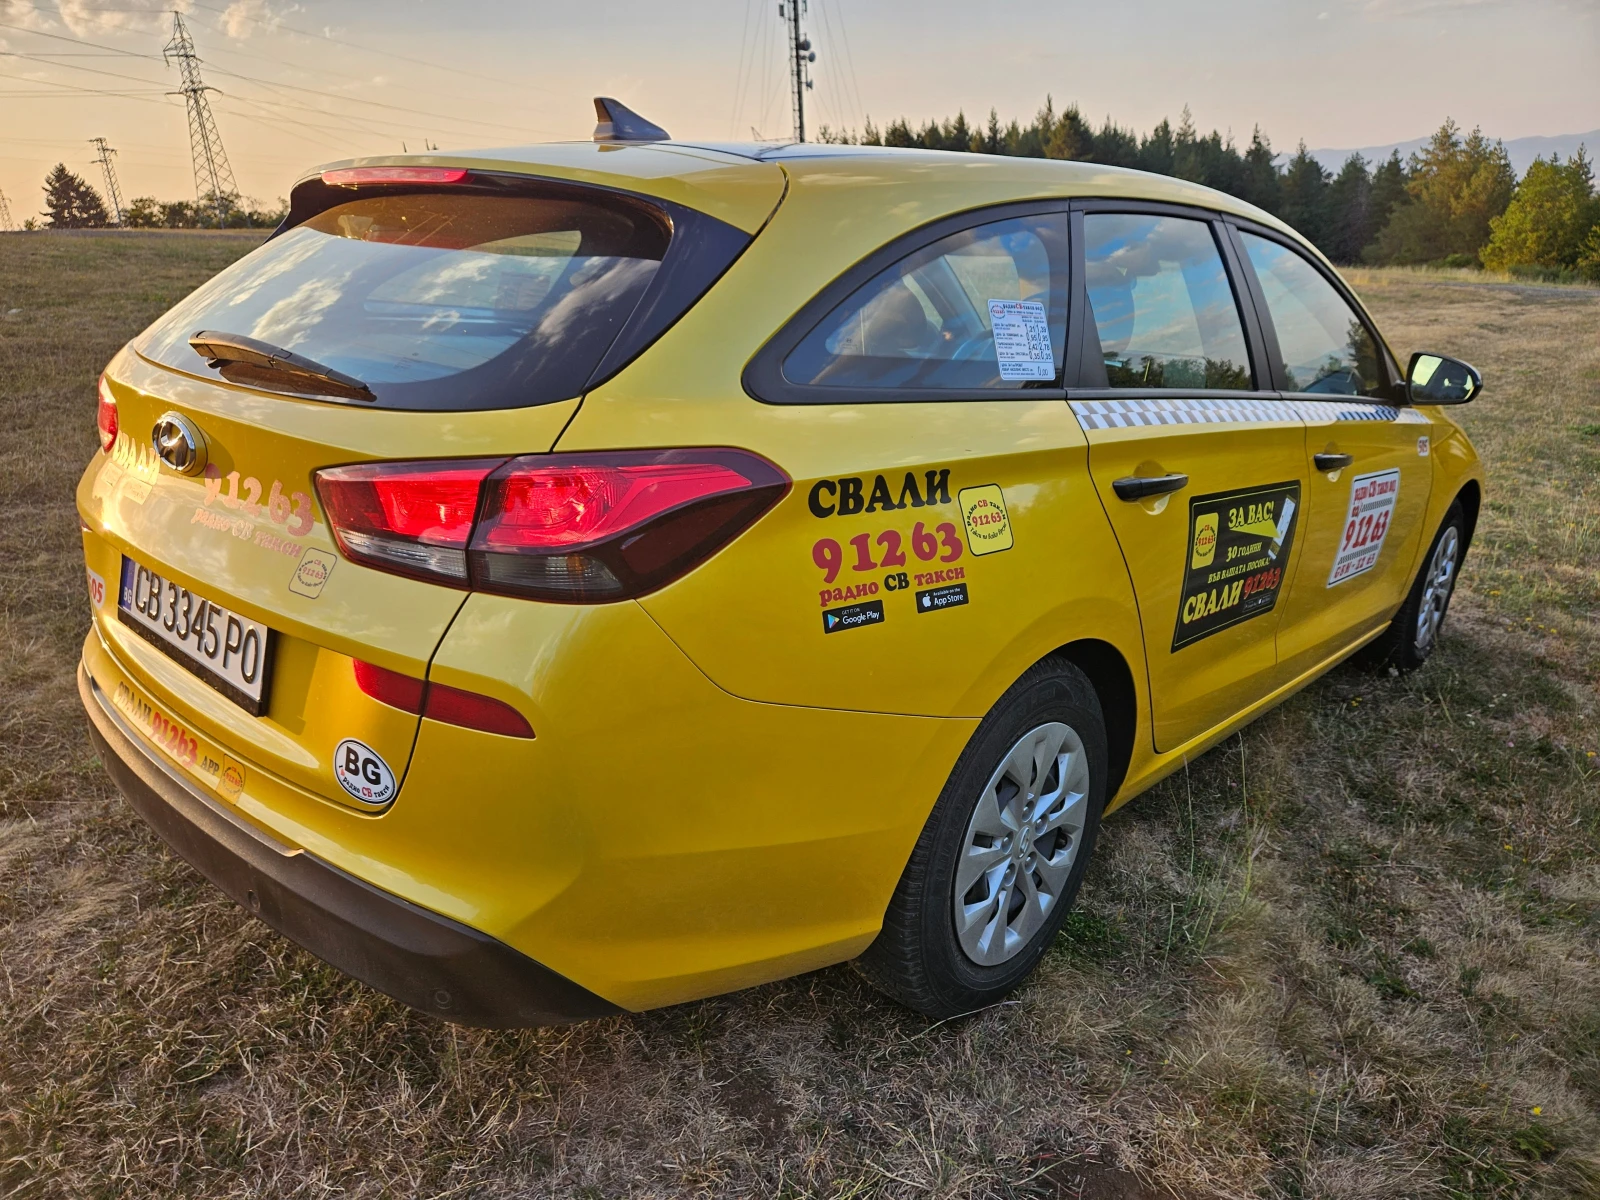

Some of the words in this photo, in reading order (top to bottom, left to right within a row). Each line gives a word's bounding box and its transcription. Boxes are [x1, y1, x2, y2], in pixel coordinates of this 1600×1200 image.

[203, 462, 314, 537] 91263
[808, 468, 952, 518] СВАЛИ
[972, 512, 1002, 528] 91263
[1228, 506, 1244, 528] ЗА
[1248, 500, 1274, 525] ВАС!
[1342, 510, 1390, 552] 91263
[812, 522, 963, 584] 91263
[1226, 546, 1238, 562] 30
[302, 566, 324, 580] 91263
[818, 582, 879, 607] радио
[884, 572, 910, 592] СВ
[914, 566, 966, 586] такси
[123, 586, 132, 604] BG
[934, 596, 947, 606] App
[947, 594, 964, 603] Store
[1182, 579, 1244, 624] СВАЛИ
[1244, 567, 1281, 600] 91263
[842, 613, 866, 625] Google
[866, 610, 880, 620] Play
[149, 711, 198, 767] 91263
[200, 755, 220, 776] APP
[344, 745, 381, 785] BG
[362, 786, 372, 798] СВ
